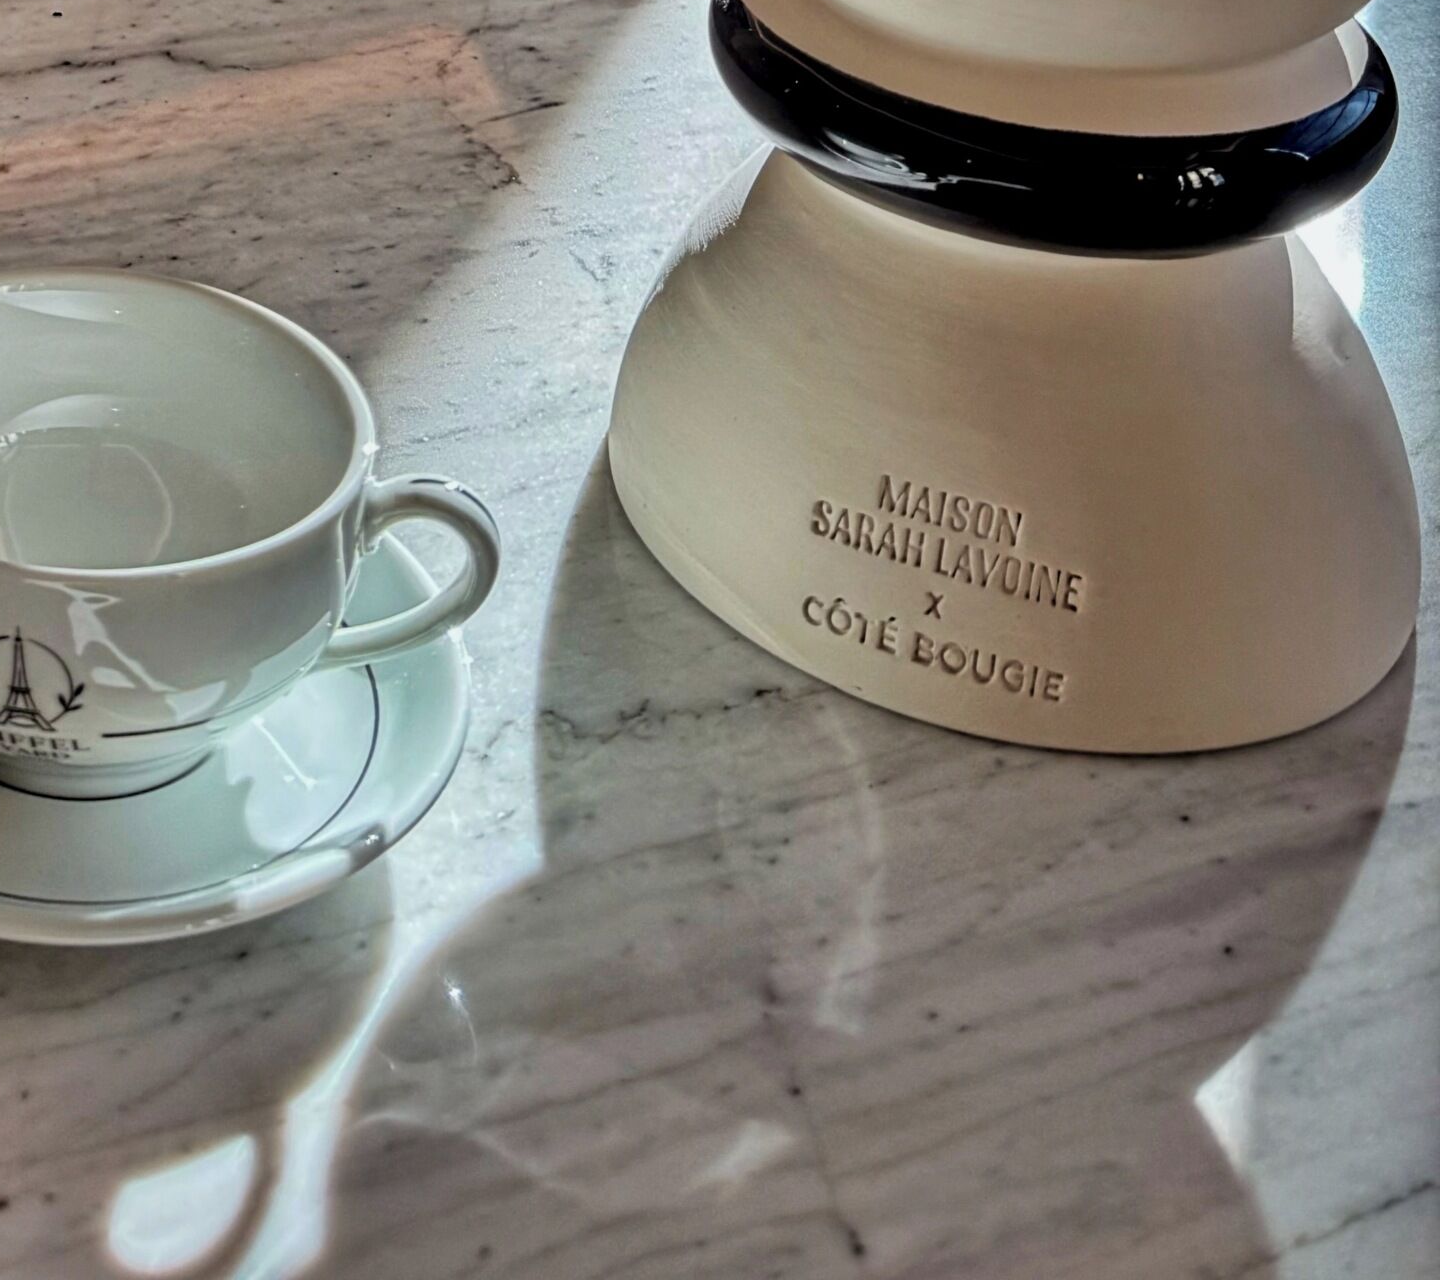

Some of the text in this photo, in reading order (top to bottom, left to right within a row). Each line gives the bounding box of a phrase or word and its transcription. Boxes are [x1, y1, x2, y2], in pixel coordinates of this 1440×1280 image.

[810, 499, 1084, 614] SARAH LAVOINE
[877, 473, 1023, 548] MAISON
[801, 594, 1067, 704] CÔTÉ BOUGIE
